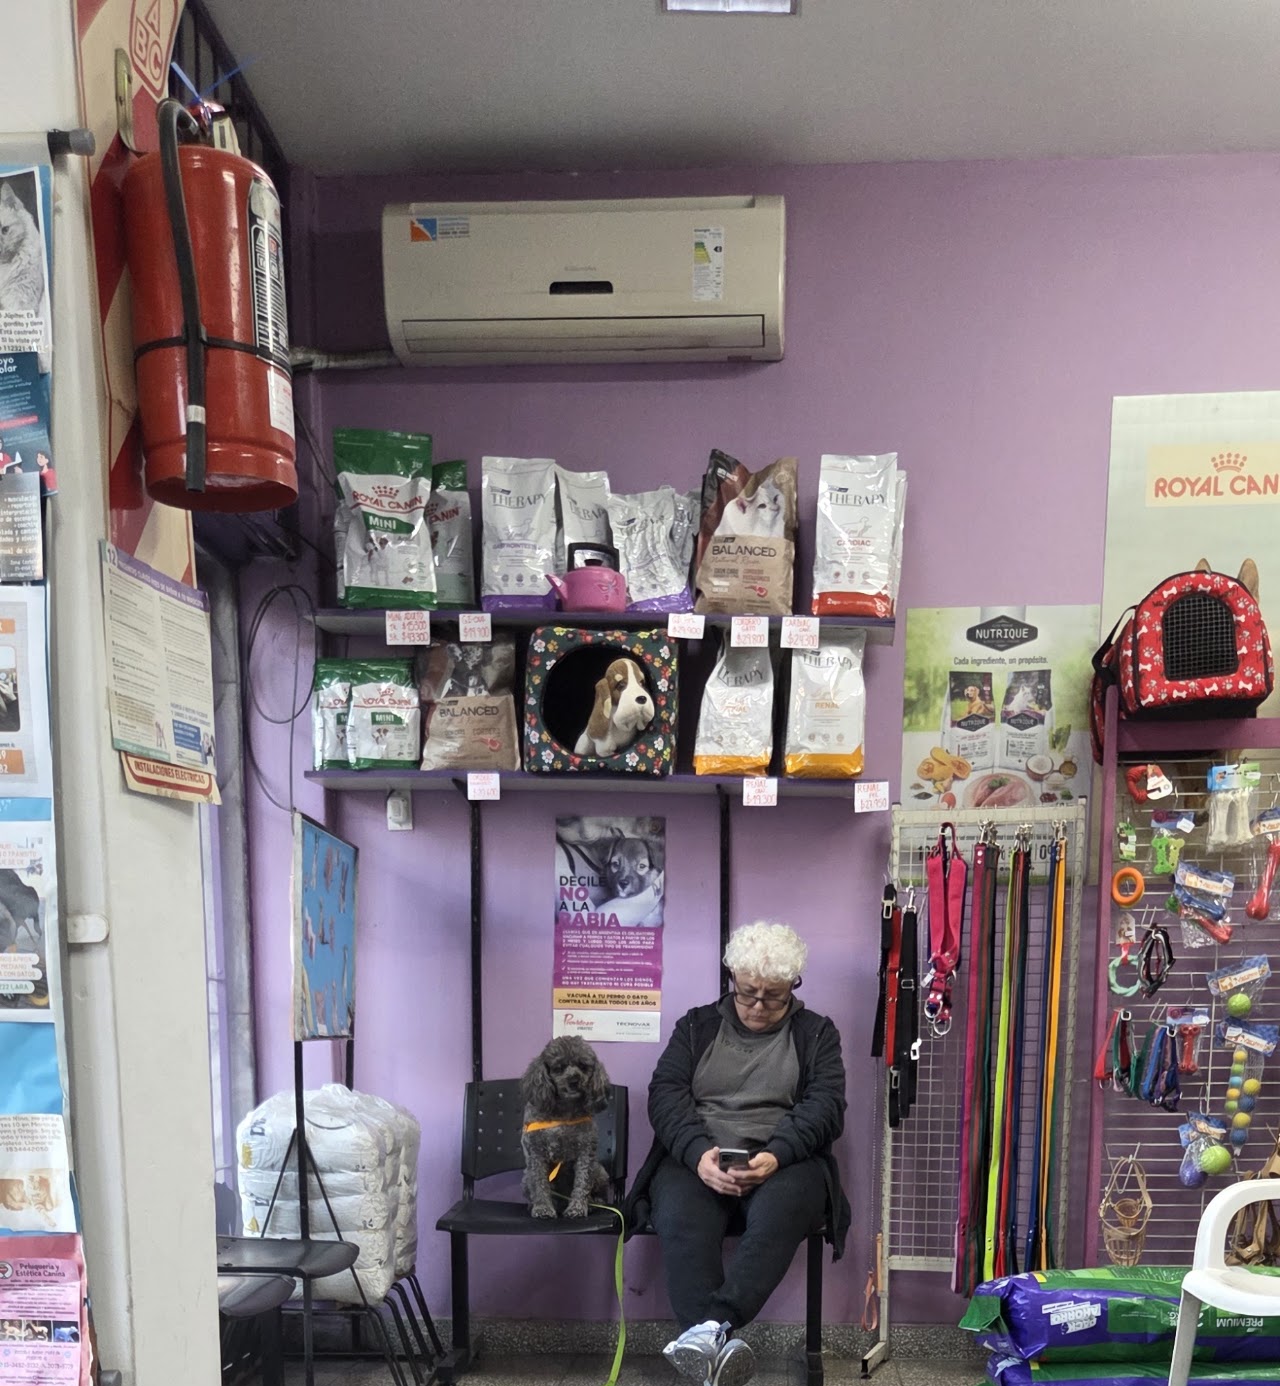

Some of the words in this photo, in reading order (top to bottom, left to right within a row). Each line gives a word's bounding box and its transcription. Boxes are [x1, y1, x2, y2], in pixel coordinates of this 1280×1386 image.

[1154, 476, 1224, 498] ROYAL
[1229, 474, 1280, 495] CAN
[352, 491, 385, 508] ROYAL
[388, 495, 423, 510] CANIN
[491, 493, 547, 508] THERAPY
[828, 491, 885, 505] THERAPY
[369, 515, 397, 530] MINI
[712, 545, 776, 557] BALANCED
[975, 628, 1029, 639] NUTRIQUE
[954, 657, 969, 665] Cada
[375, 714, 394, 722] MINI
[440, 706, 499, 718] BALANCED
[134, 761, 175, 780] INSTALACIONES
[175, 769, 205, 785] ELECTRICAS
[560, 875, 607, 887] DECILE
[560, 887, 589, 901] NO
[560, 902, 568, 911] A
[573, 902, 589, 911] LA
[559, 912, 620, 927] RABIA
[1051, 1304, 1101, 1325] AHORRO
[1216, 1318, 1263, 1328] PREMIUM
